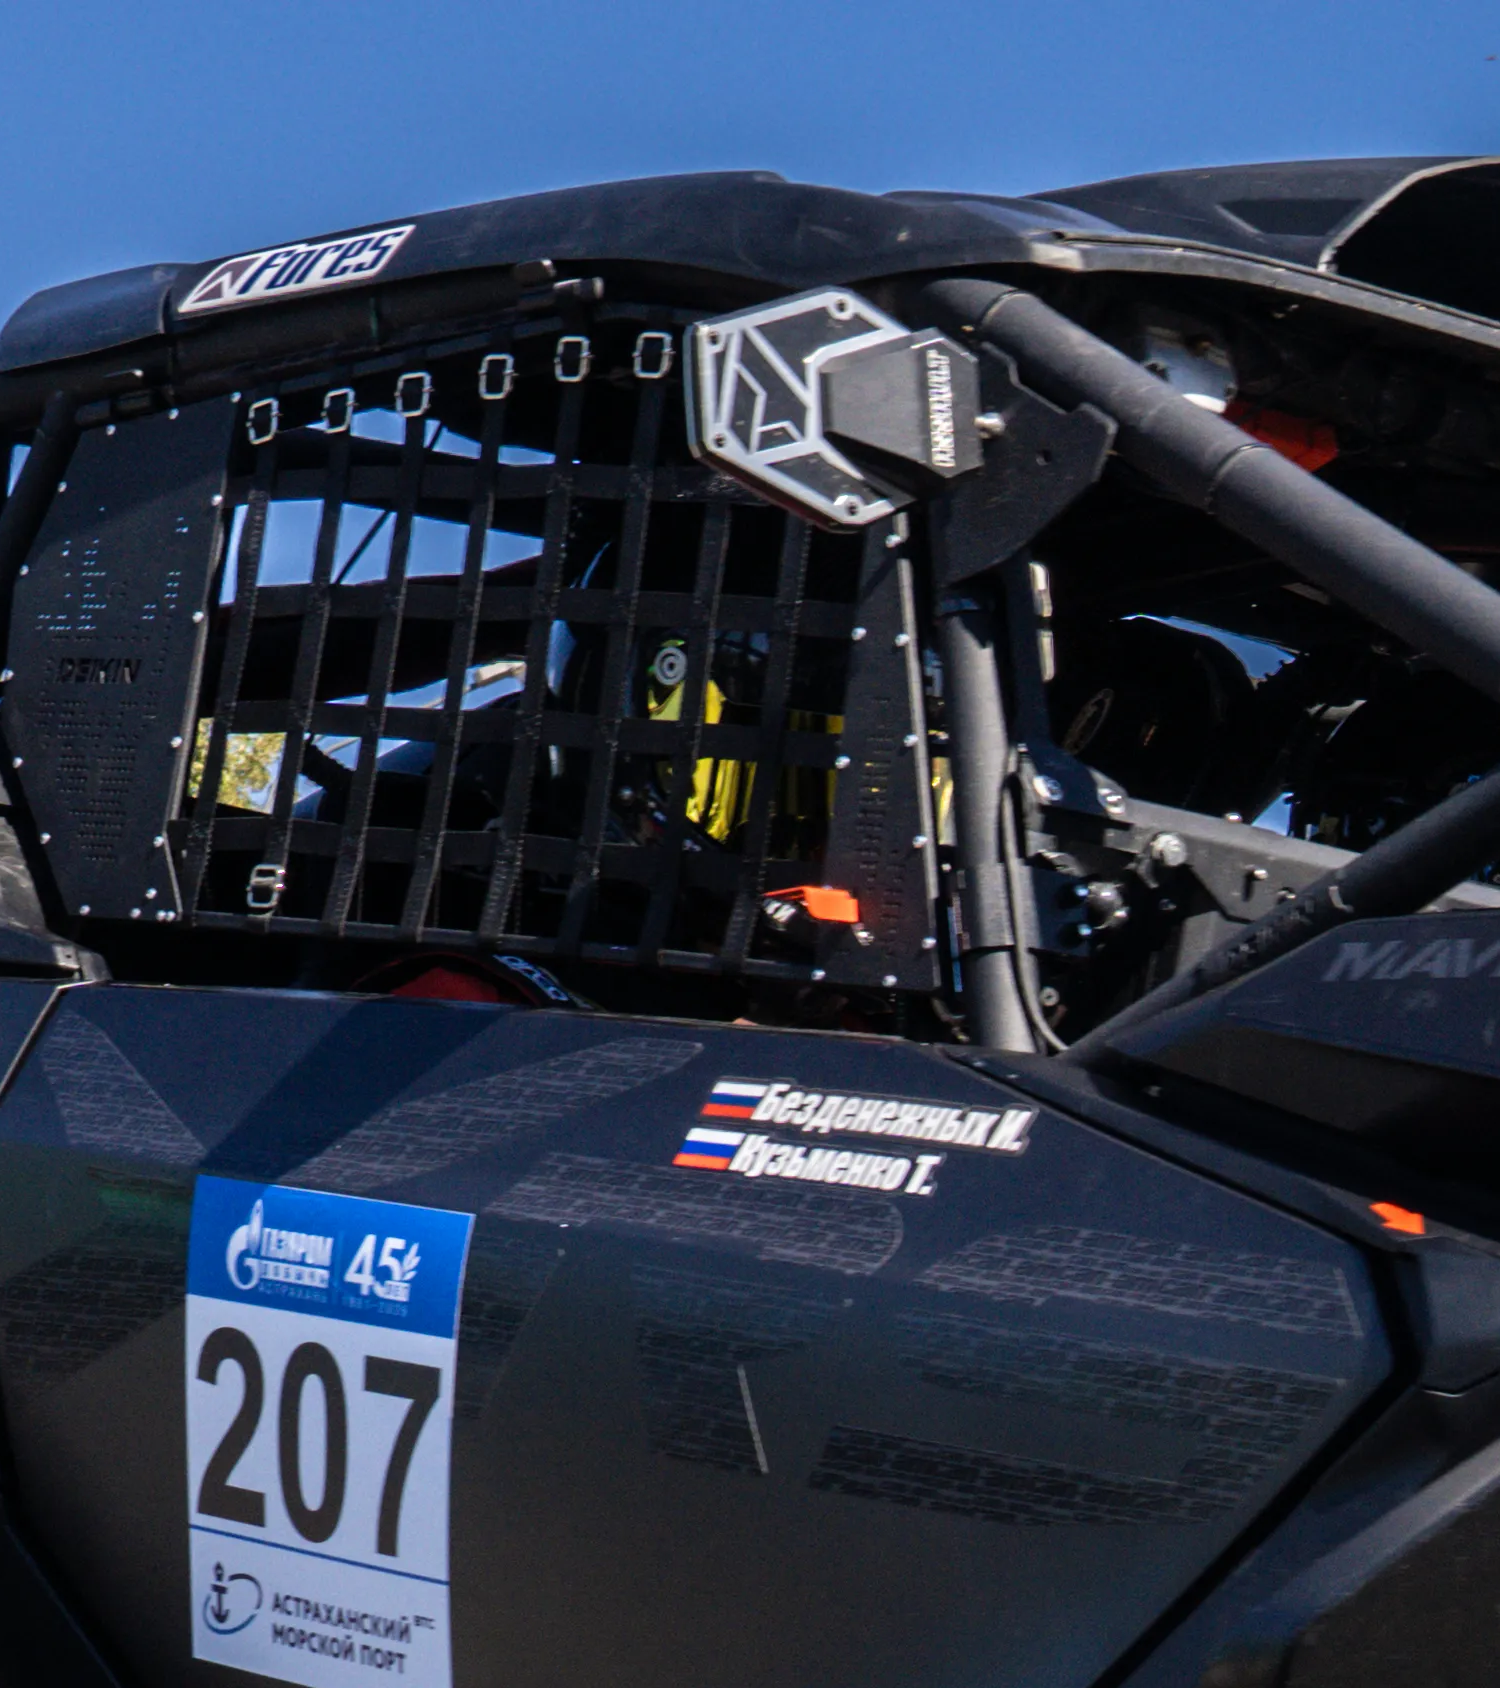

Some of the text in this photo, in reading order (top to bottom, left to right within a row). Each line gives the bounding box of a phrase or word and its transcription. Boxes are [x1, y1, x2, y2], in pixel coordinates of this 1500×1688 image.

[750, 1083, 1033, 1151] Безденежных И.
[728, 1134, 941, 1196] Кузьменко Т.
[344, 1234, 407, 1302] 45
[197, 1326, 441, 1557] 207
[272, 1592, 412, 1644] АСТРАХАНСКИЙ
[272, 1622, 407, 1674] МОРСКОЙ ПОРТ
